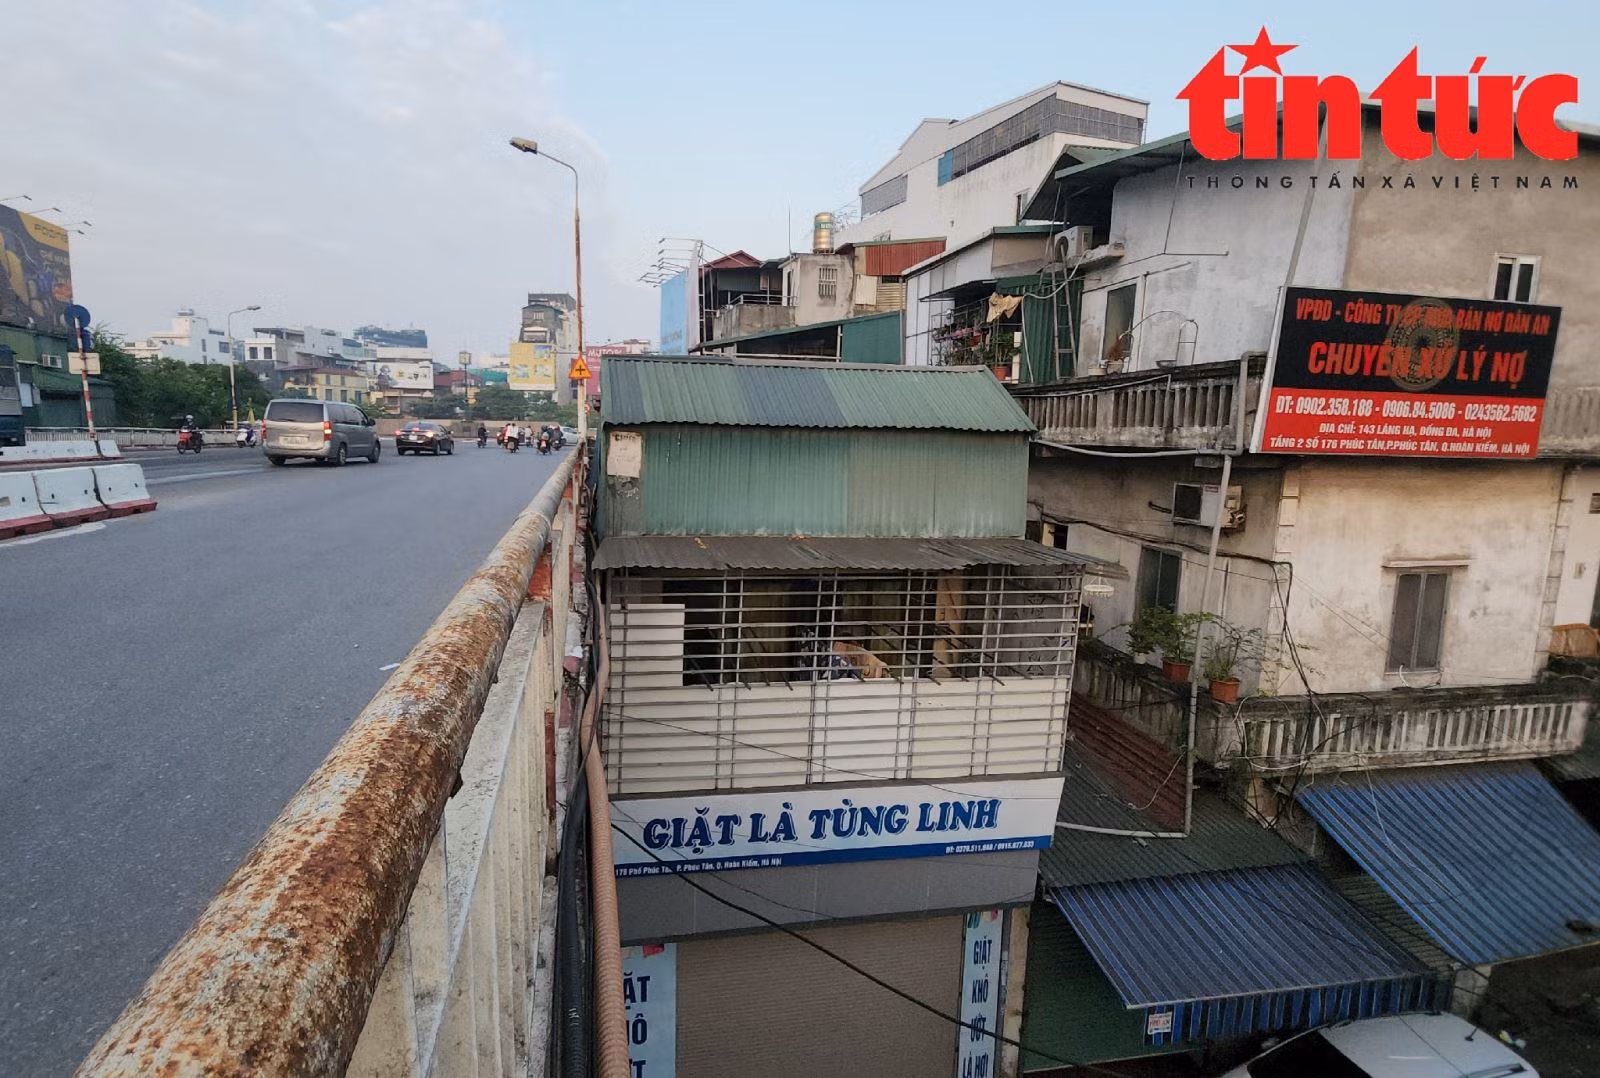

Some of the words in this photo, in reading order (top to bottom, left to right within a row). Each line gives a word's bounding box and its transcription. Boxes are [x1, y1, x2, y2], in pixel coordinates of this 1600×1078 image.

[1344, 298, 1382, 324] CÔNG
[1386, 304, 1402, 326] TY
[1456, 306, 1483, 331] BÁN
[1531, 314, 1551, 336] AN
[1308, 338, 1412, 377] CHUYÊN
[1456, 344, 1487, 381] LÝ
[1490, 349, 1528, 389] NỢ
[1295, 396, 1373, 416] 0902.358.188
[1296, 438, 1305, 448] 2
[1305, 435, 1320, 449] SỐ
[1321, 439, 1338, 449] 176
[1339, 438, 1365, 450] PHÚC
[1501, 443, 1513, 454] HÀ
[1319, 423, 1335, 435] ĐỊA
[1337, 421, 1356, 434] CHỈ:
[1358, 424, 1376, 434] 143
[1462, 425, 1474, 437] HÀ
[642, 807, 742, 854] GIẶT
[748, 802, 798, 843] LÀ
[809, 799, 908, 840] TÙNG
[916, 799, 1002, 833] LINH
[973, 936, 992, 970] GIẶT
[624, 971, 650, 1010] ẶT
[971, 973, 989, 1004] KHÔ
[963, 1050, 972, 1078] LÀ
